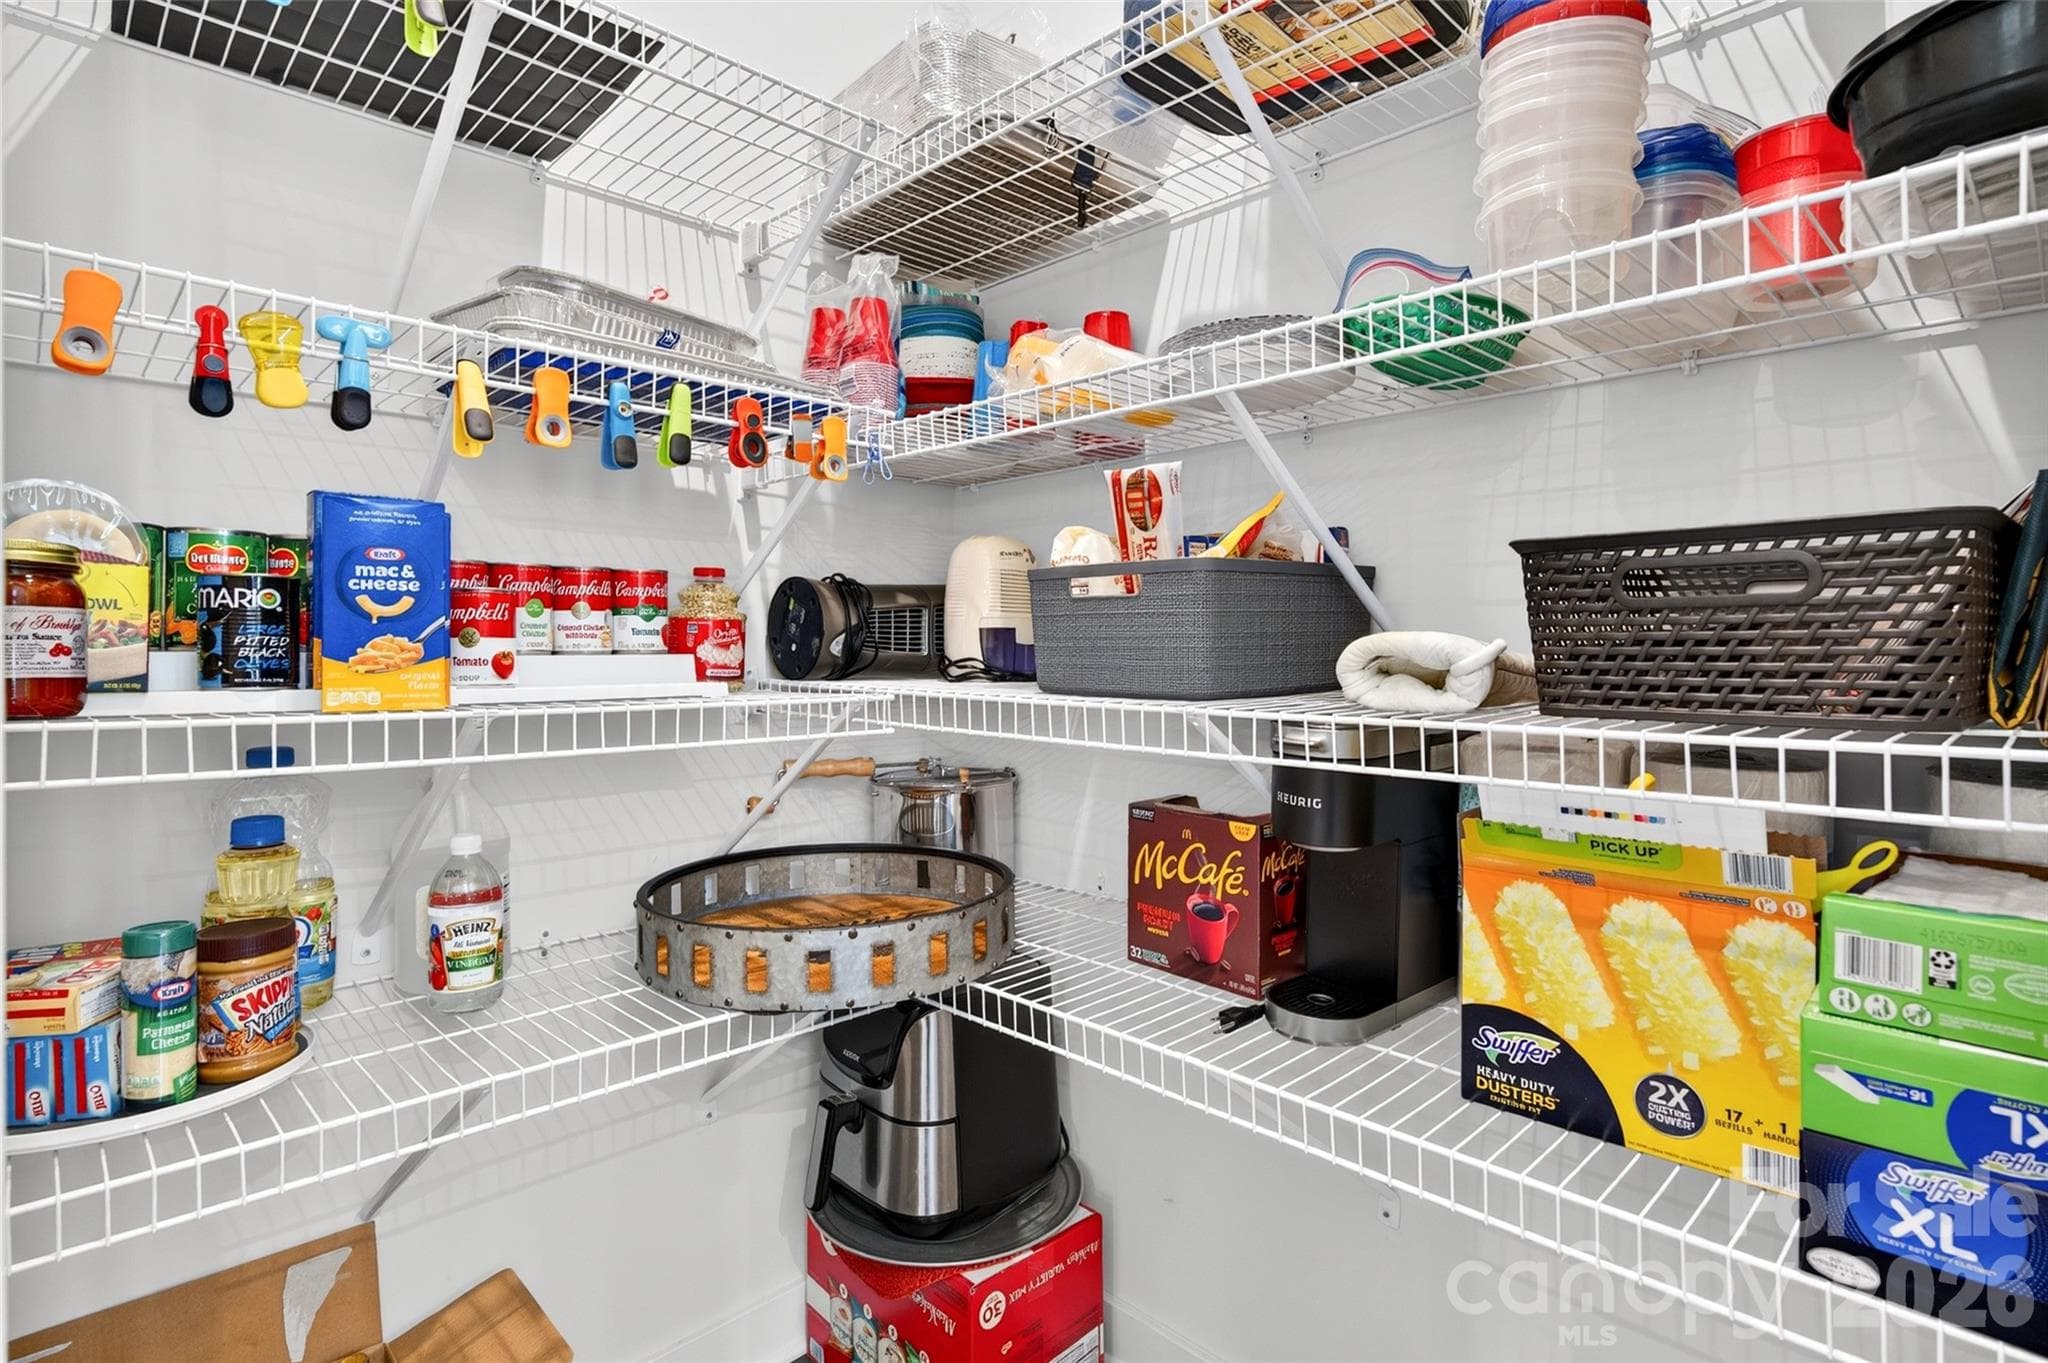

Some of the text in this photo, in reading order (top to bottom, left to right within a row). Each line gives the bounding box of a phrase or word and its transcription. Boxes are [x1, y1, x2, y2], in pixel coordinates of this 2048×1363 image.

[355, 564, 416, 578] mac &
[234, 636, 290, 646] PITTED
[238, 647, 286, 658] BLACK
[452, 656, 488, 666] Tomato
[1276, 790, 1322, 809] KEURIG
[1590, 840, 1630, 856] PICK
[1134, 840, 1246, 900] McCafé
[1136, 902, 1180, 922] PREMIUM
[452, 922, 491, 938] HEINZ
[1143, 914, 1174, 930] ROAST
[1130, 945, 1142, 960] 32
[162, 984, 184, 996] Kraft
[1472, 1026, 1557, 1065] Swiffer
[1476, 1064, 1556, 1096] HEAVY DUTY
[1648, 1080, 1690, 1112] 2X
[1724, 1108, 1744, 1122] 17
[1779, 1122, 1787, 1134] 1
[1715, 1118, 1800, 1147] REFILLS HANDL
[1878, 1162, 1984, 1206] Swiffer
[1888, 1198, 1979, 1262] XL
[983, 1300, 1002, 1324] 30
